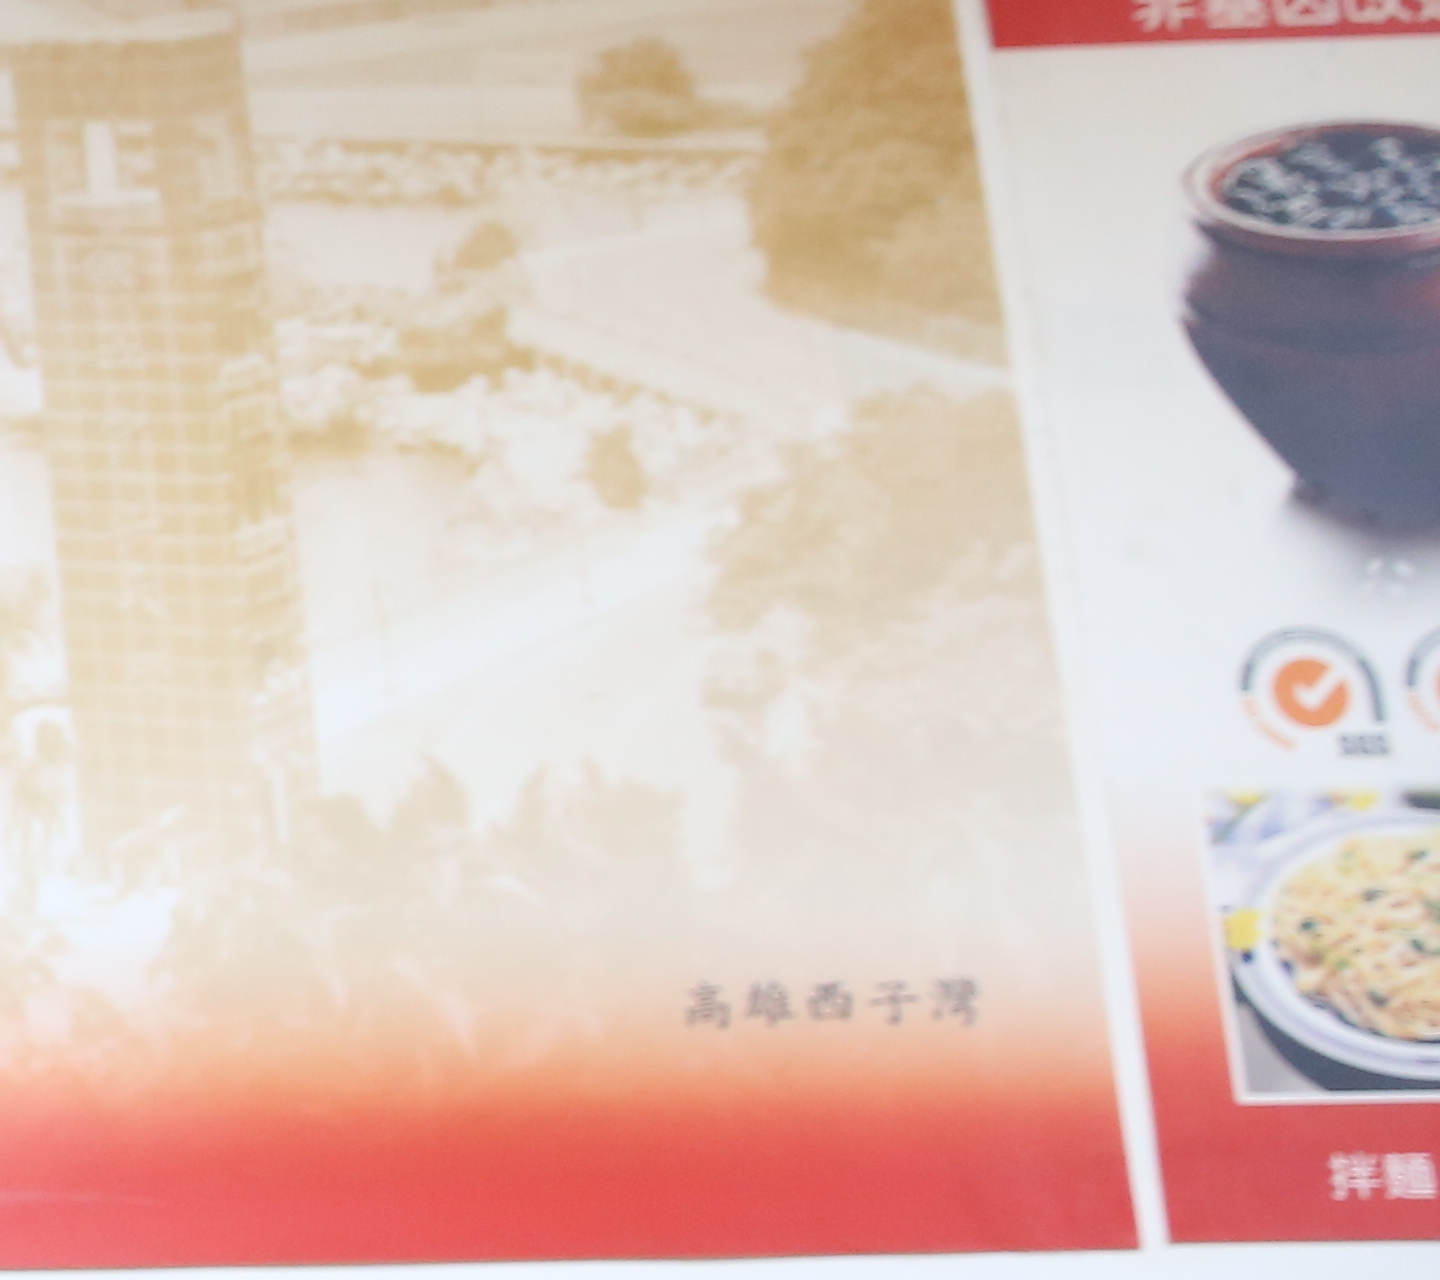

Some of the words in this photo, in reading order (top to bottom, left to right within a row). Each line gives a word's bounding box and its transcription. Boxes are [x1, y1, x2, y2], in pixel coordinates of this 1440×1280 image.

[684, 976, 982, 1030] 高雄西子灣
